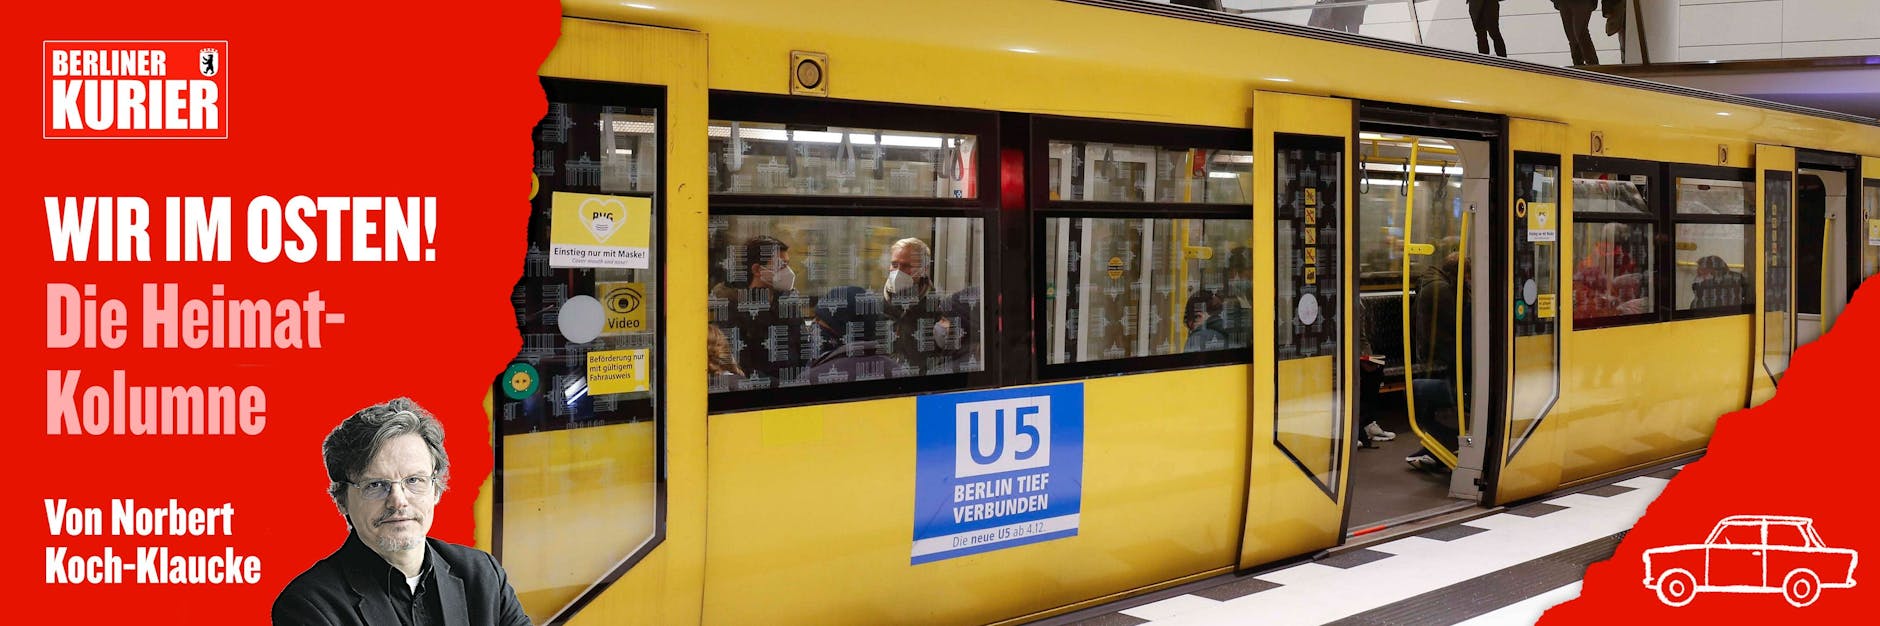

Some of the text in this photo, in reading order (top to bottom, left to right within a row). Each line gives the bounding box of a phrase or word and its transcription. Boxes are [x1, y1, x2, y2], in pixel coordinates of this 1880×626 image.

[554, 247, 645, 259] Einstieg nur mit Maske!
[608, 317, 640, 329] Video
[589, 354, 632, 363] Beförderung
[602, 363, 633, 373] gültigem
[589, 372, 631, 381] Fahrausweis
[969, 405, 1040, 465] U5
[954, 472, 1049, 503] BERLIN TIEF
[953, 494, 1048, 524] VERBUNDEN
[952, 535, 969, 548] Die
[970, 531, 995, 545] neue
[998, 527, 1011, 540] U5
[1012, 525, 1025, 537] ab
